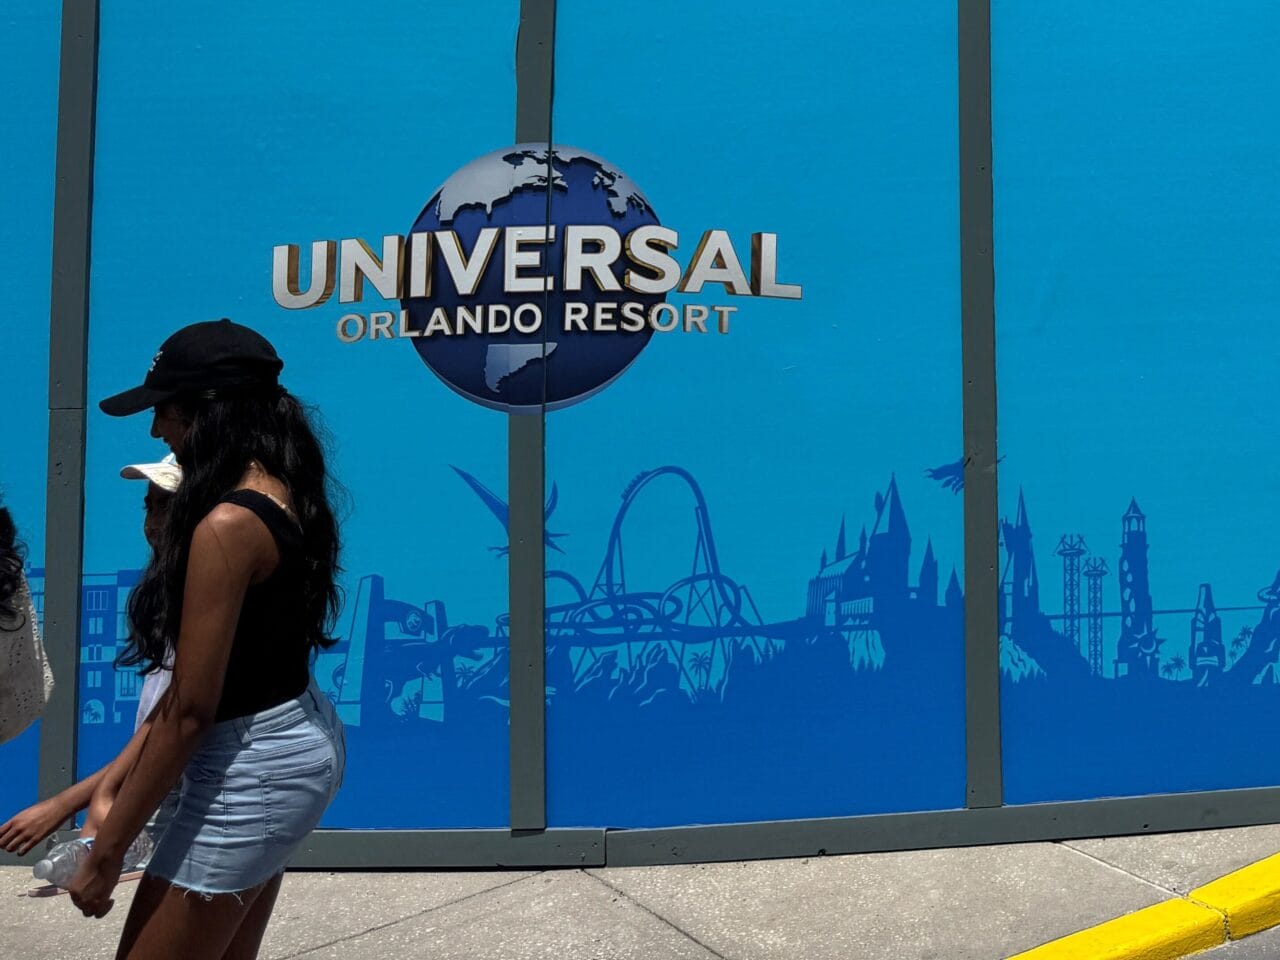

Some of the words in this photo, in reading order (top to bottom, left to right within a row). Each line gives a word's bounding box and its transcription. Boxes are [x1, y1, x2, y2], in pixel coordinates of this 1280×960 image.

[271, 224, 803, 310] UNIVERSAL
[336, 303, 543, 344] ORLANDO
[563, 301, 739, 335] RESORT
